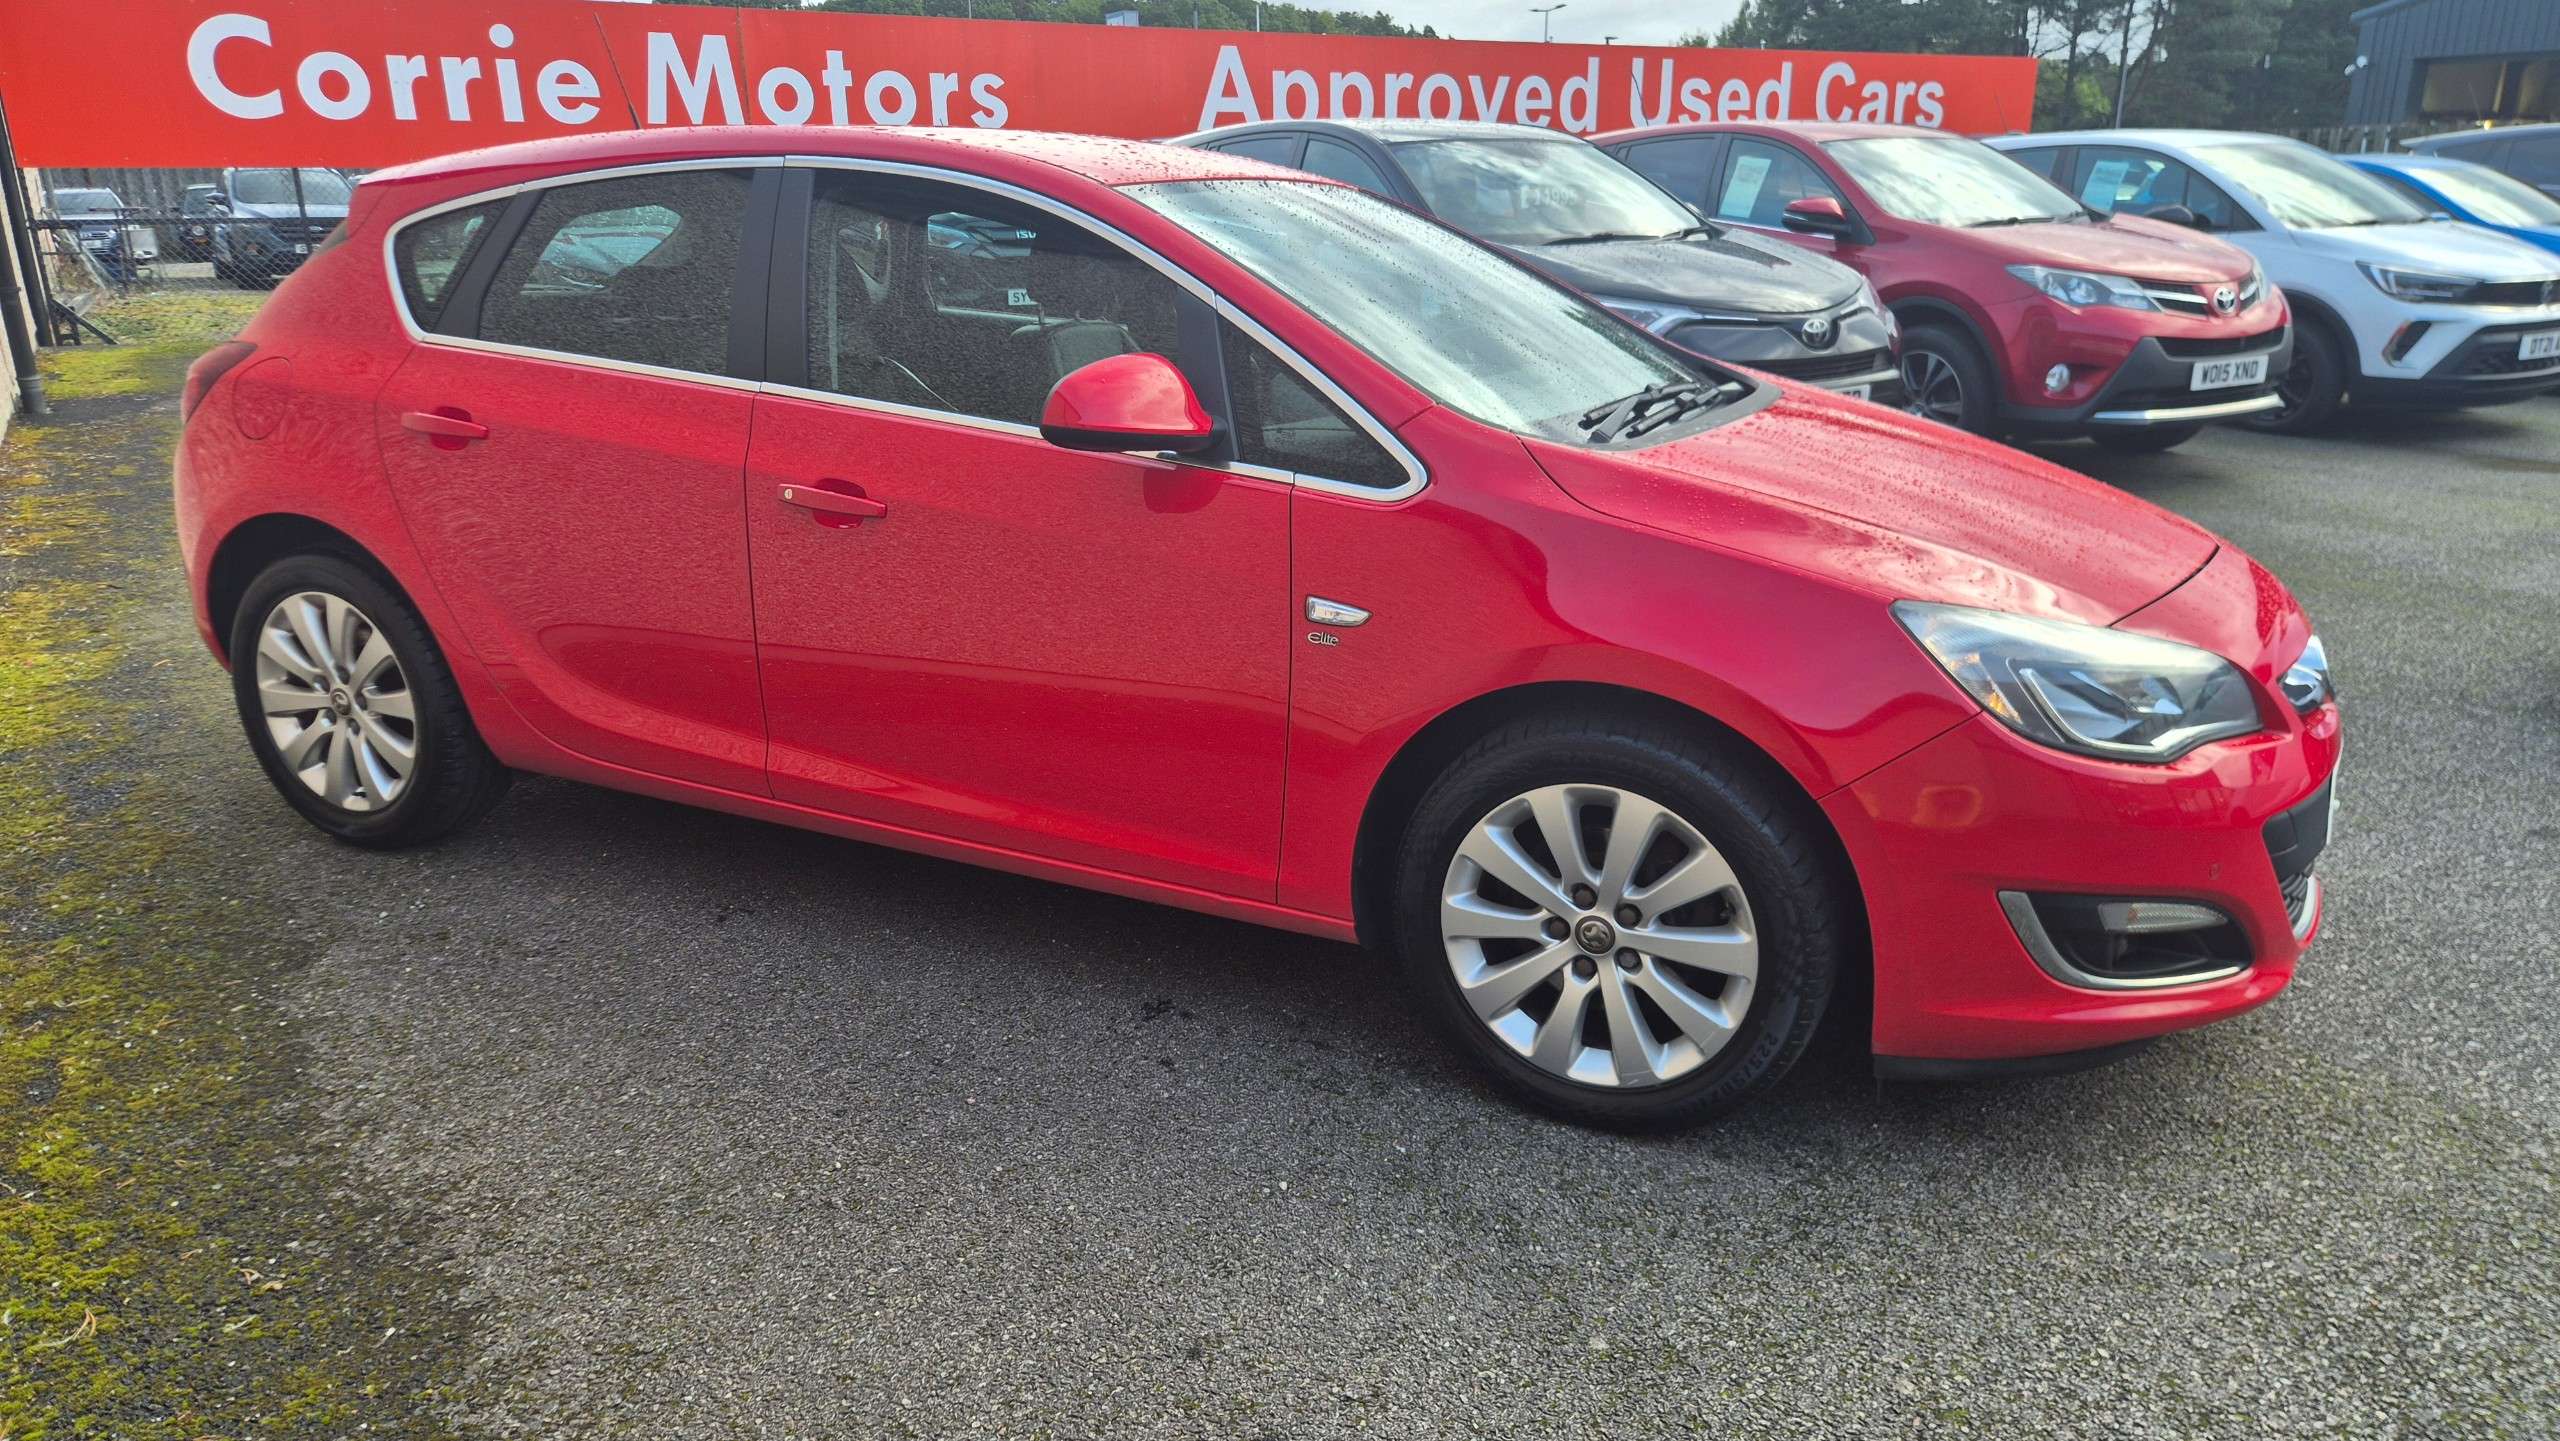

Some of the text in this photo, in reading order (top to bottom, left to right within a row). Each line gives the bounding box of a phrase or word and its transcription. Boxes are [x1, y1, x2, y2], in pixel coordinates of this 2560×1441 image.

[187, 13, 1009, 129] Corrie Motors
[1197, 44, 1945, 133] Approved Used Cars
[2233, 359, 2260, 381] XND
[1307, 631, 1339, 647] Elite
